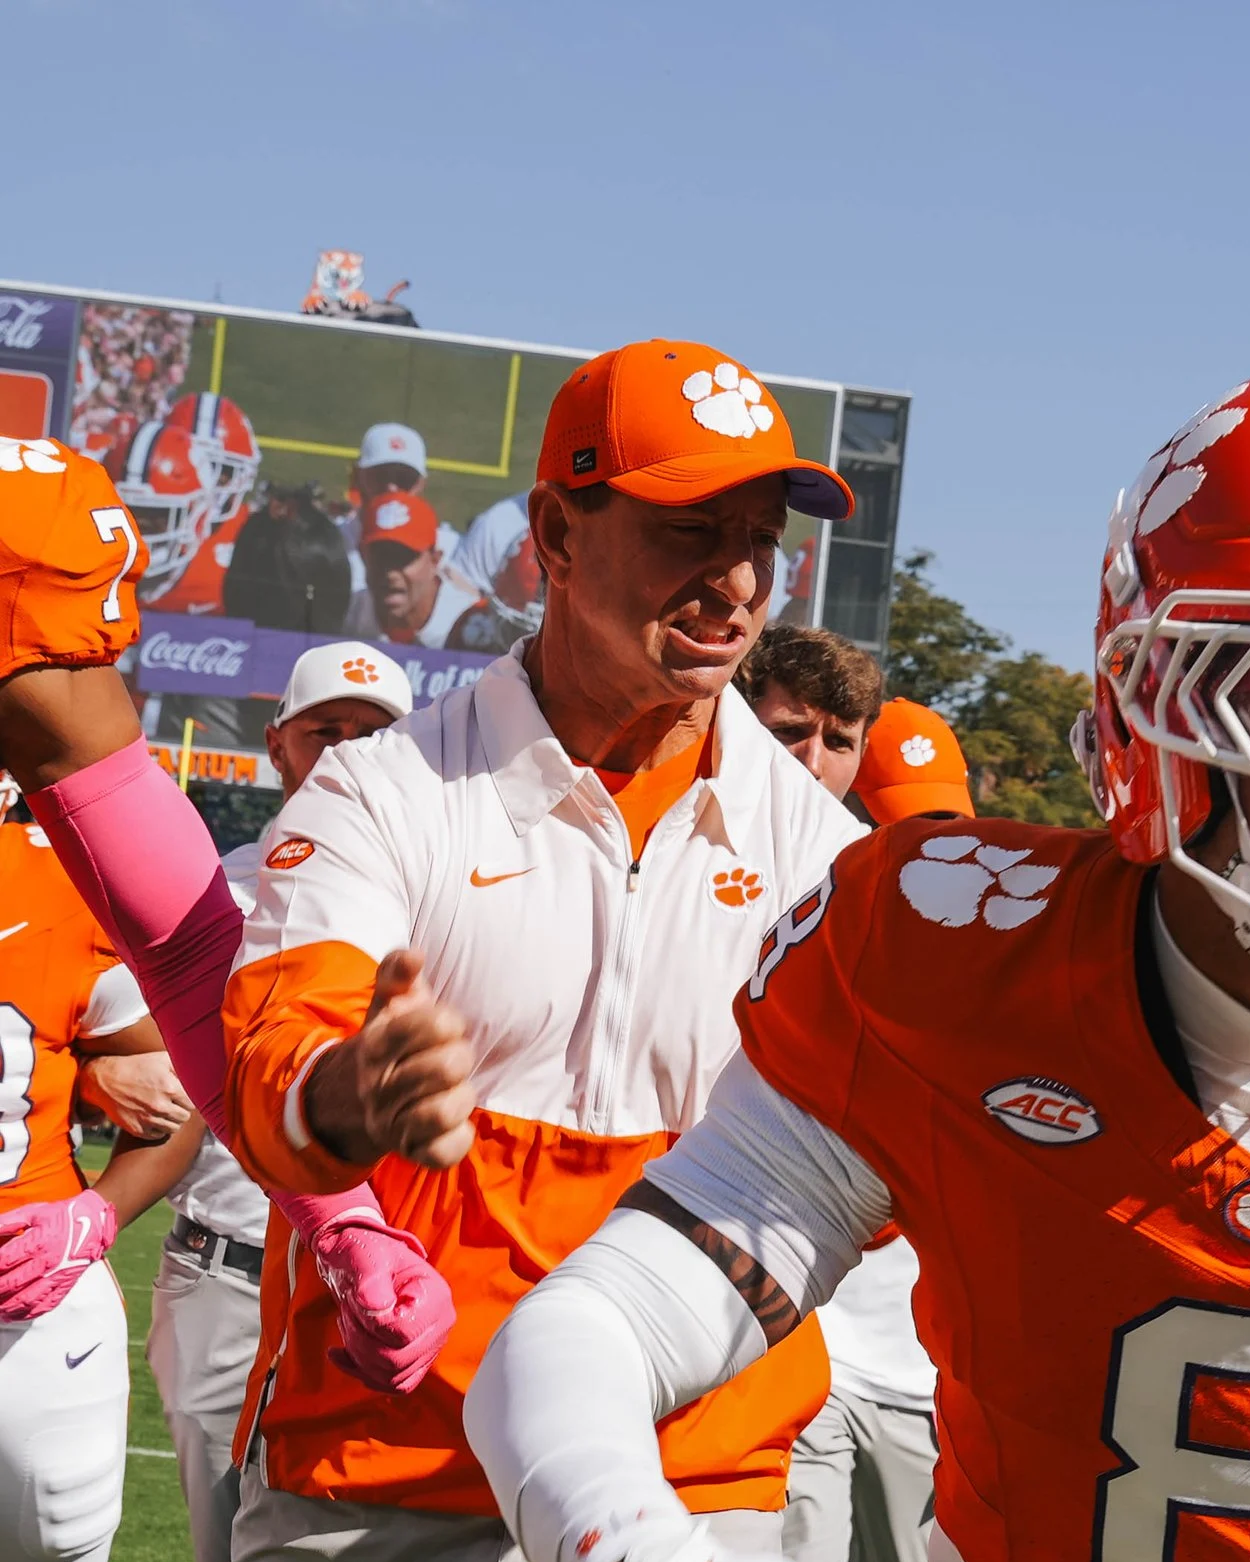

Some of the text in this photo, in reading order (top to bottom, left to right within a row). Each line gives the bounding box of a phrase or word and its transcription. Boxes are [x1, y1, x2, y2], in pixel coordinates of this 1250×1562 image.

[90, 506, 138, 623] 7
[271, 840, 313, 863] ACC
[998, 1093, 1091, 1130] ACC
